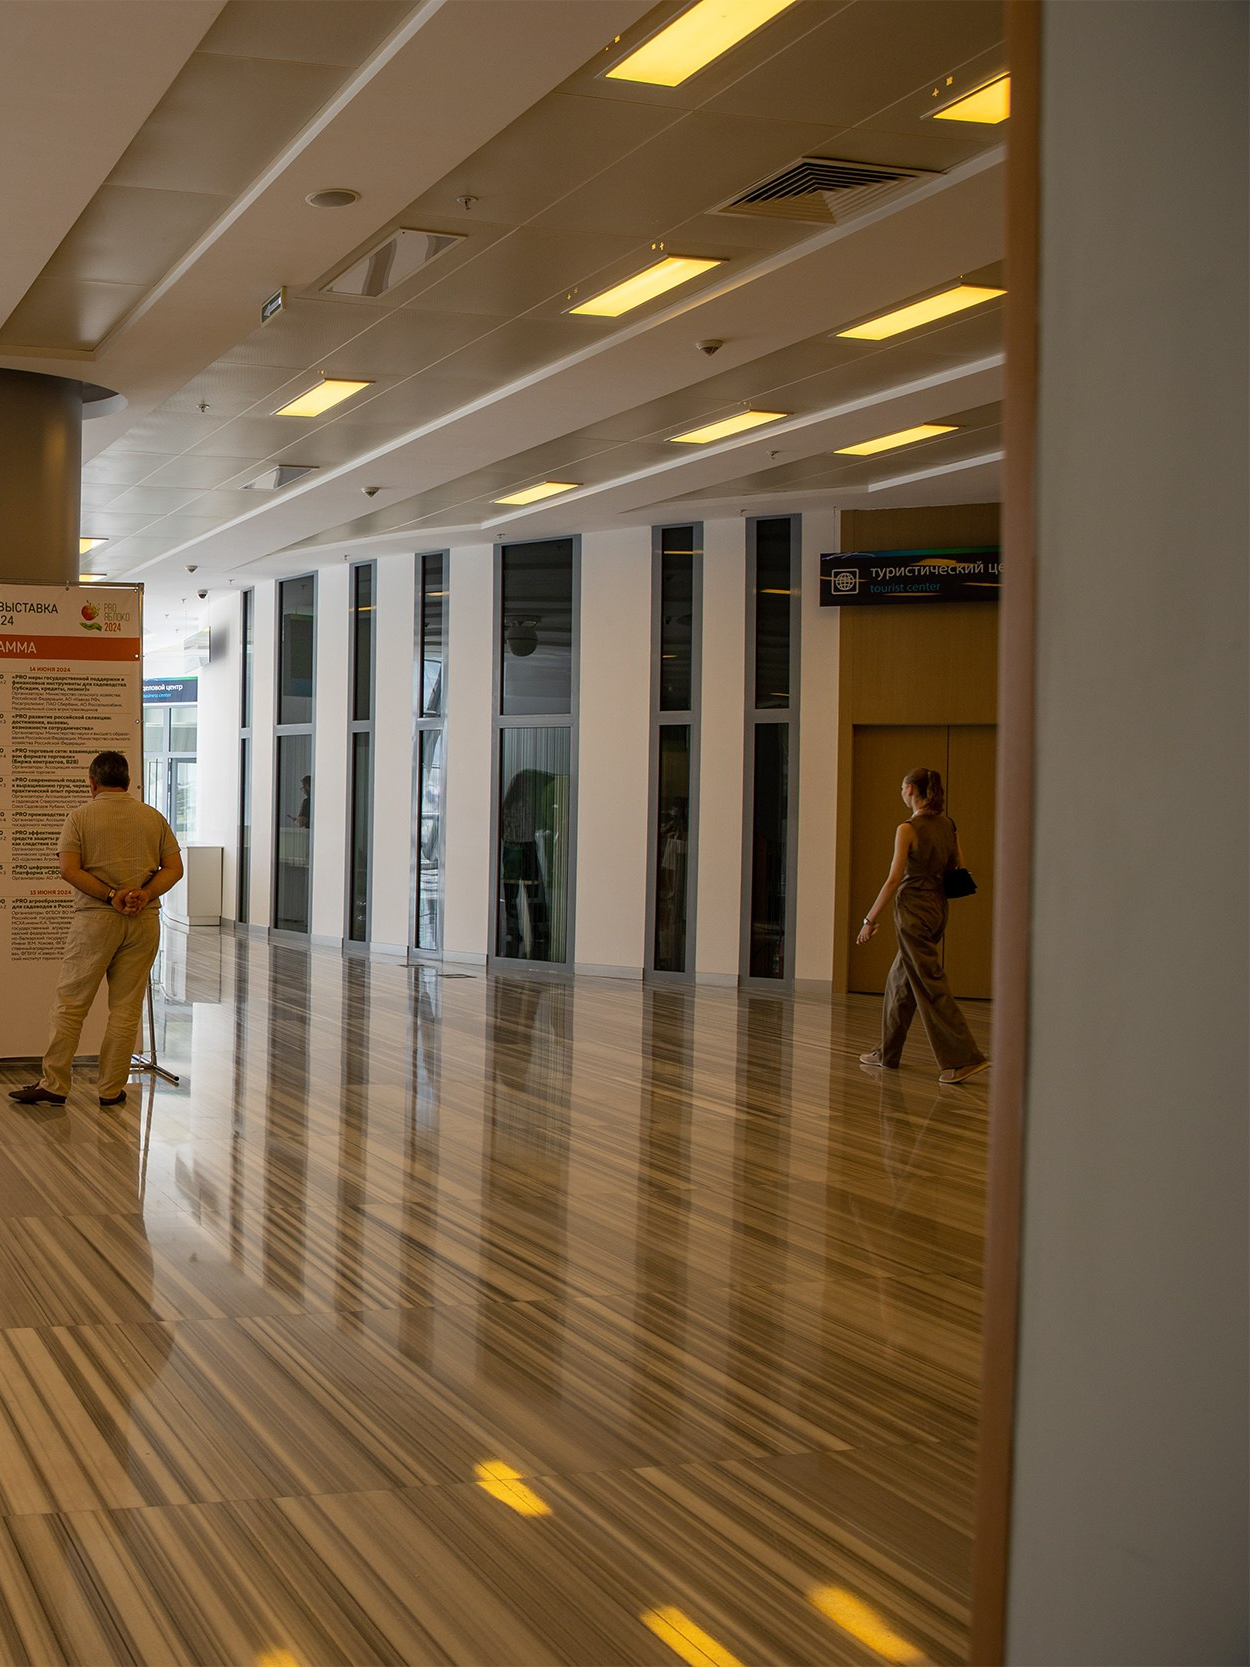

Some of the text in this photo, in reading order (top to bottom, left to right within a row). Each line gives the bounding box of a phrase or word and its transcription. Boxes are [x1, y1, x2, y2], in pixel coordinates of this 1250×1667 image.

[870, 561, 984, 580] туристический
[870, 582, 940, 593] tourist center
[104, 622, 122, 632] 2024
